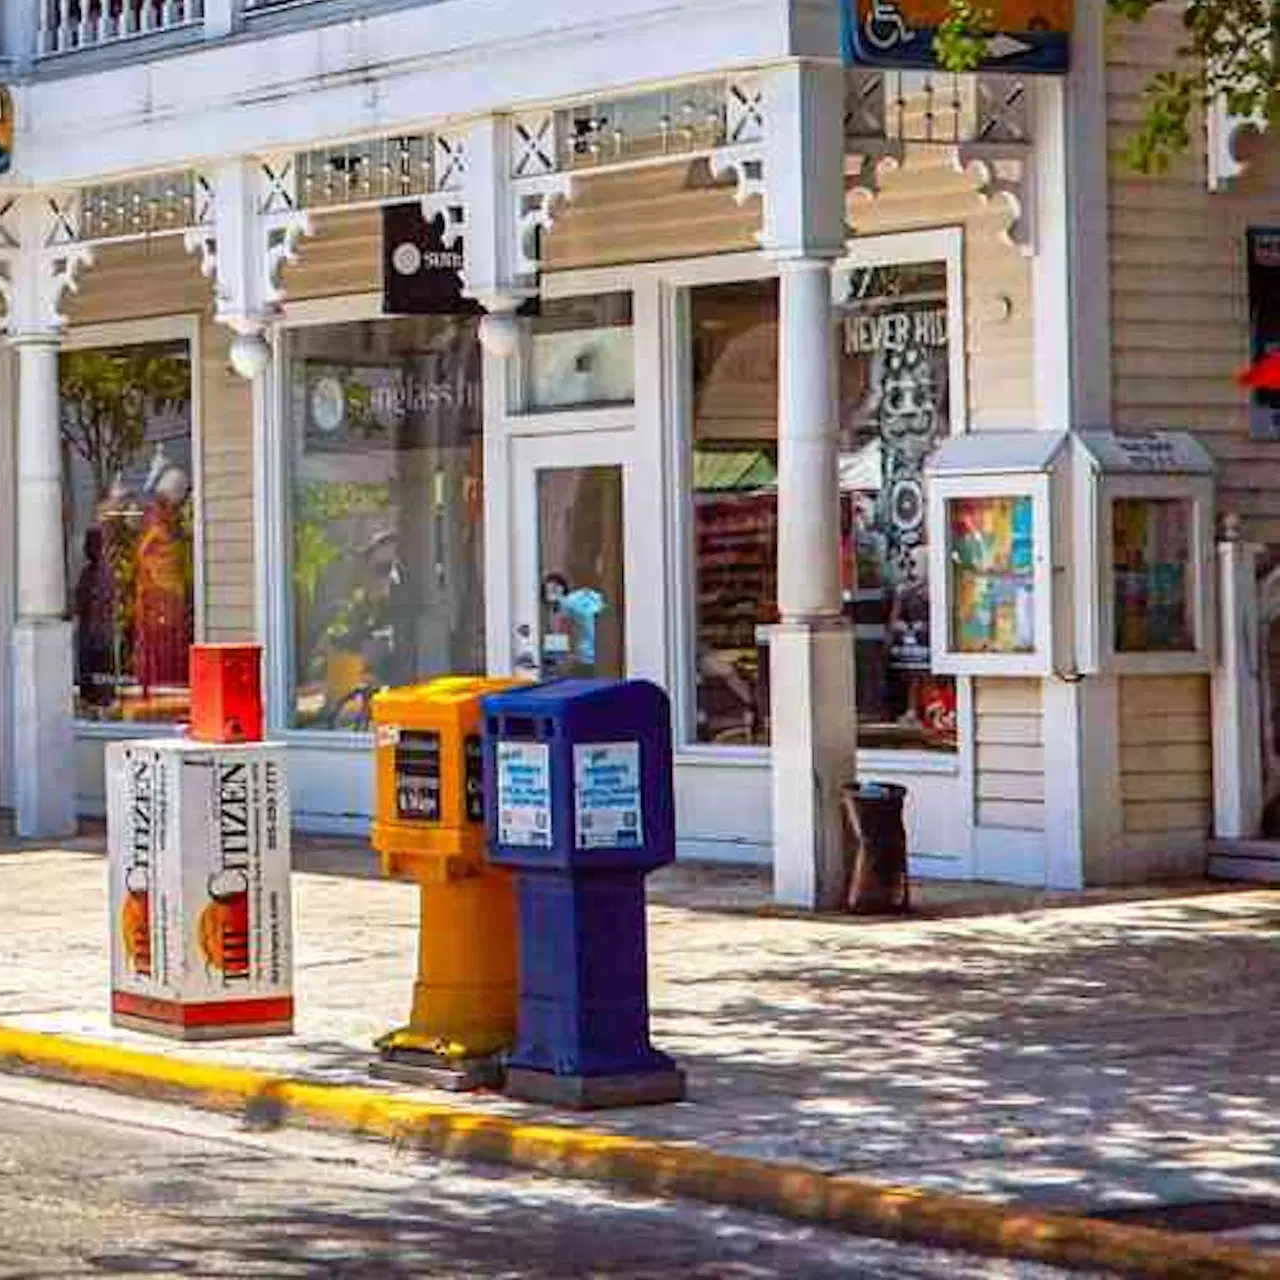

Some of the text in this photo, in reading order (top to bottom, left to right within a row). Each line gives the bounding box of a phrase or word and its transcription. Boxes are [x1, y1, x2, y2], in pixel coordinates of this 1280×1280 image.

[844, 313, 908, 353] NEVER
[125, 761, 151, 892] CITIZEN
[207, 761, 250, 988] THE CITIZEN
